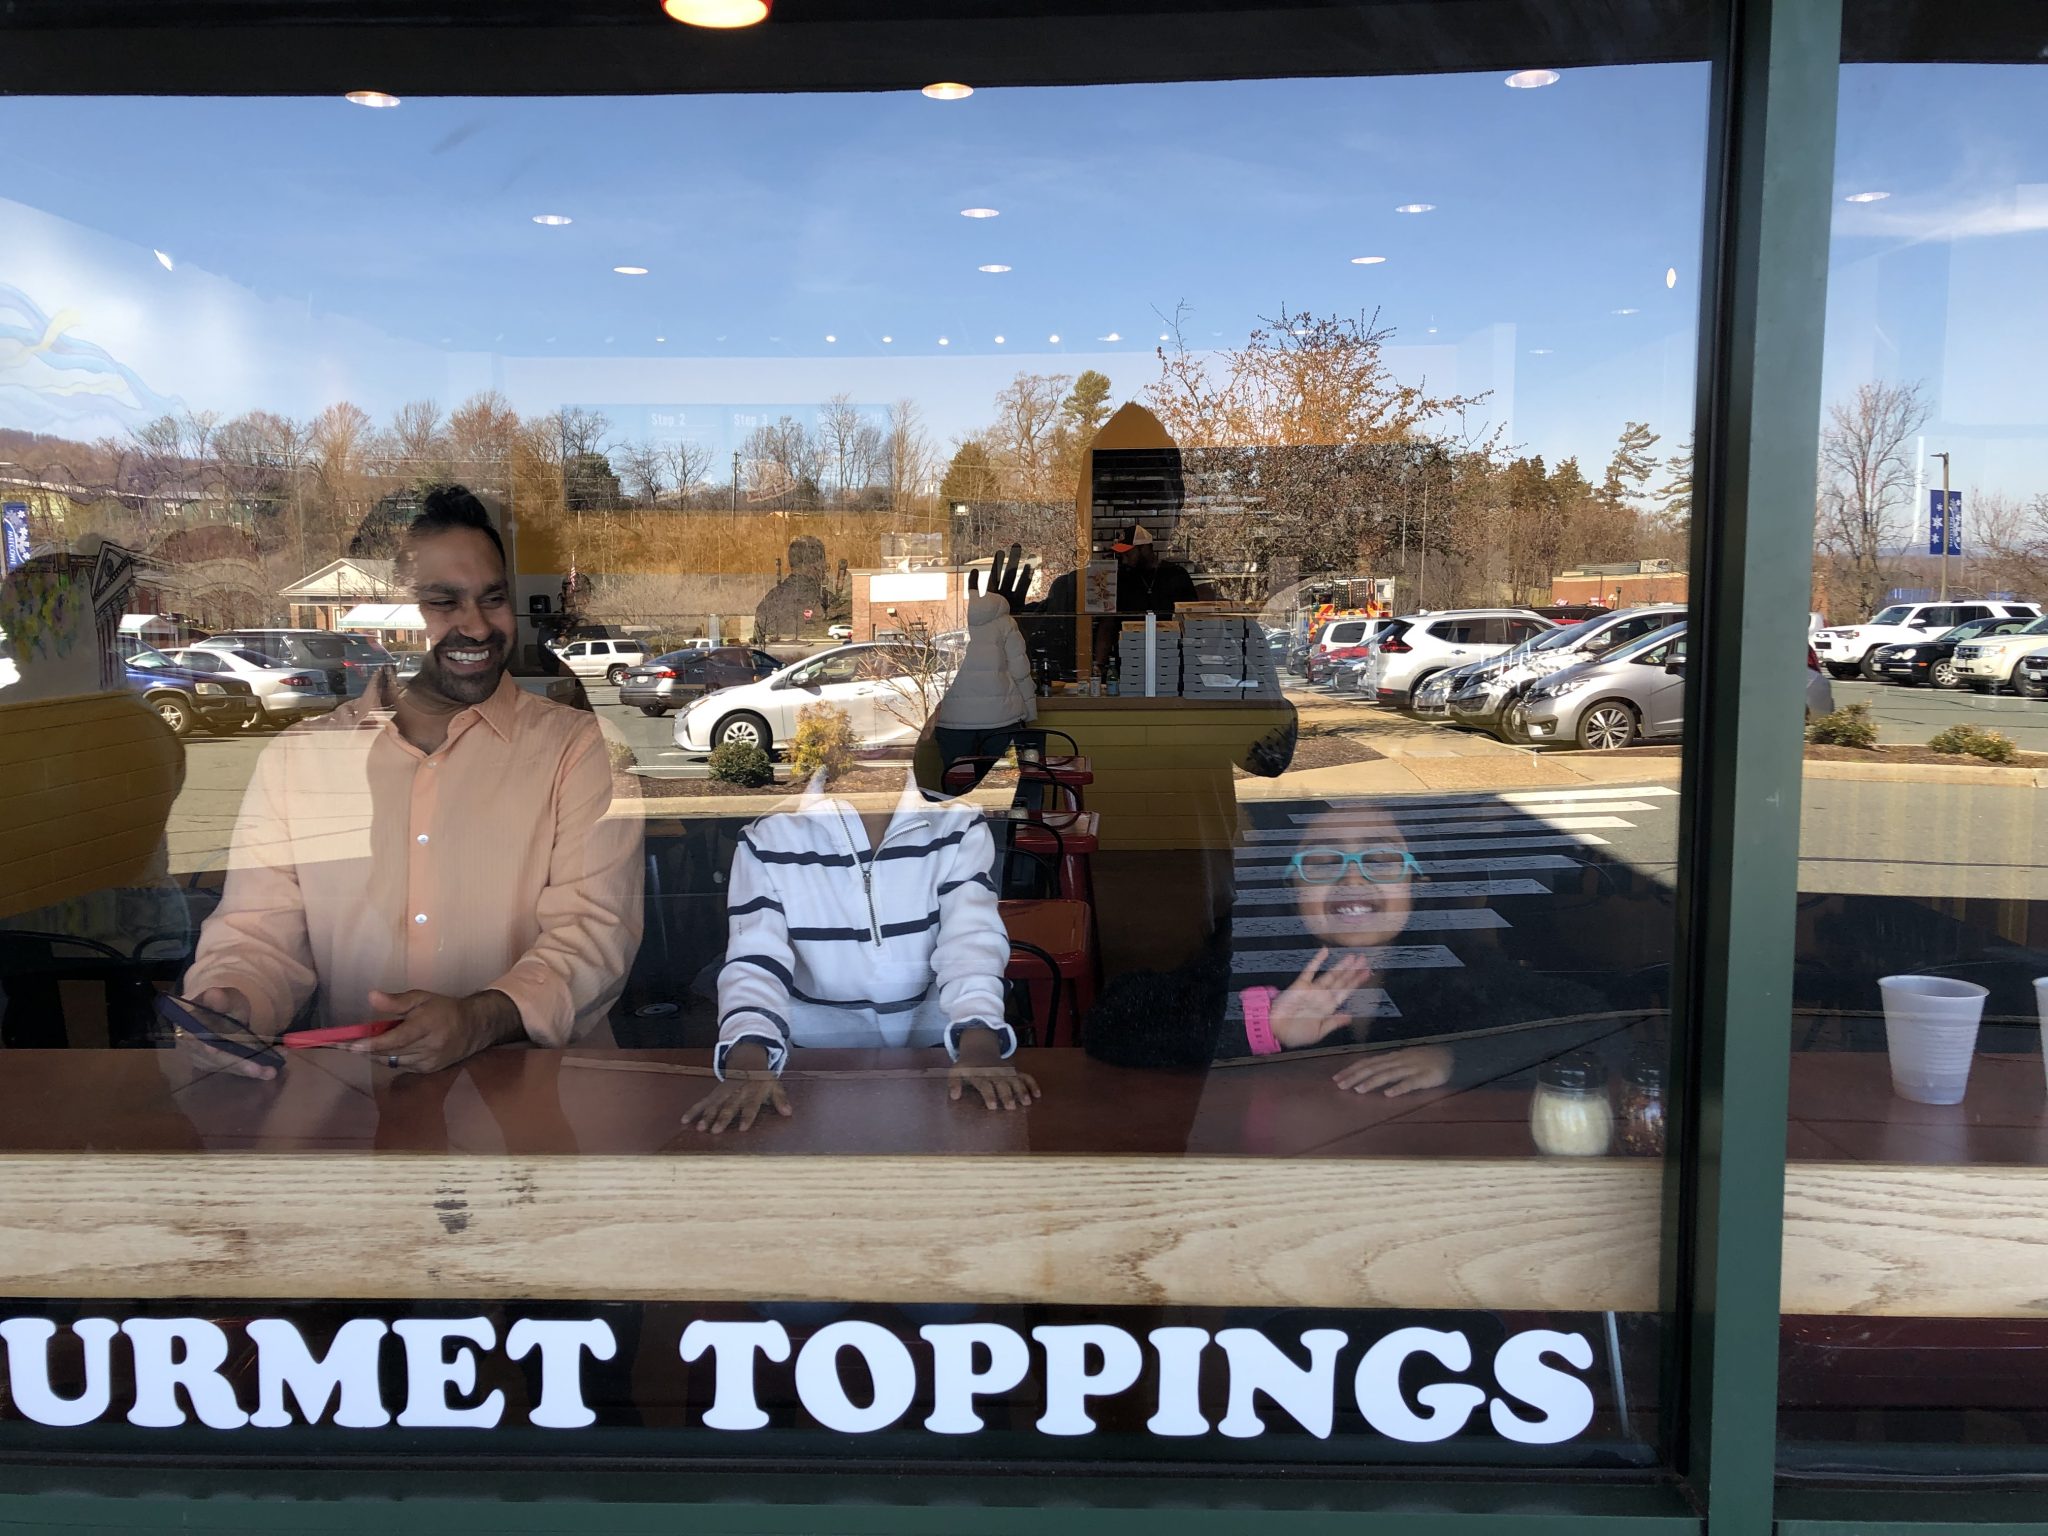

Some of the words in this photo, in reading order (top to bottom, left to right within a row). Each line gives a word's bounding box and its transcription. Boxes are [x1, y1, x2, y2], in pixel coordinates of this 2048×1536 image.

[651, 413, 675, 428] Step
[679, 413, 686, 425] 2
[734, 413, 757, 428] Step
[0, 1316, 617, 1430] URMET
[679, 1319, 1594, 1444] TOPPINGS
